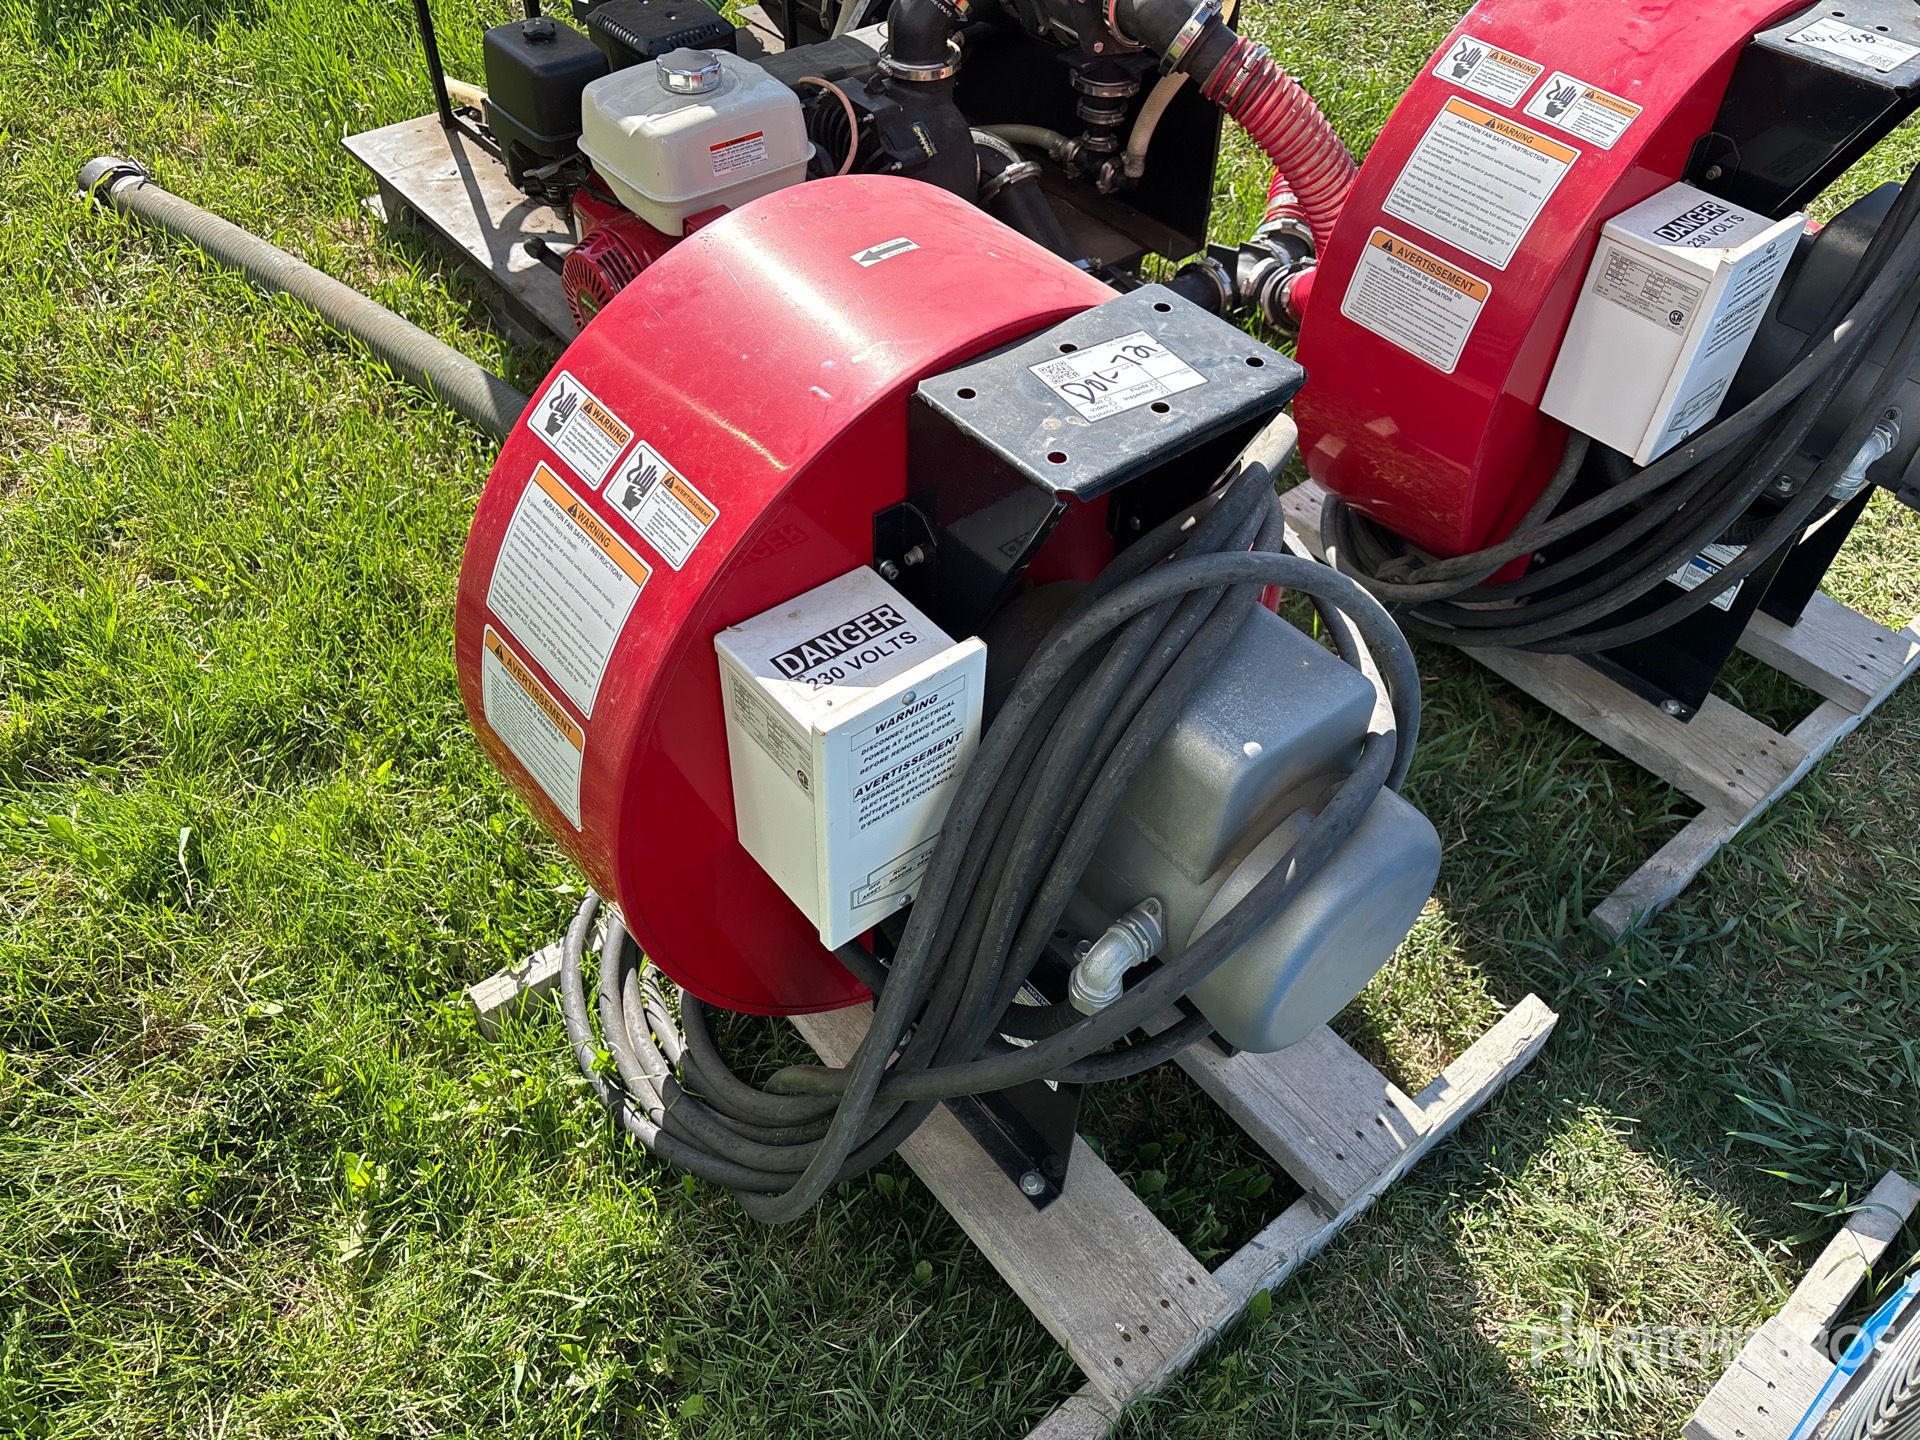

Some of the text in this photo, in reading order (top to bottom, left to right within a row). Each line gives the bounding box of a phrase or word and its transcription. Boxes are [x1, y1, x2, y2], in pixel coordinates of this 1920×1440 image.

[1499, 55, 1538, 74] WARNING
[1595, 95, 1635, 114] AVERTISSEMENT
[1455, 119, 1549, 164] AERATION FAN SAFETY INSTRUCTIONS
[1495, 122, 1534, 144] WARNING
[1656, 202, 1728, 241] DANGER
[1687, 214, 1744, 248] 230 VOLTS
[1386, 256, 1462, 299] INSTRUCTIONS DE SÉCURITÉ DU
[1389, 266, 1453, 302] VENTILATEUR D'AÉRATION
[1396, 246, 1474, 292] AVERTISSEMENT
[1123, 388, 1155, 401] Inspection
[1129, 384, 1150, 392] Fluids
[591, 408, 627, 443] WARNING
[1089, 404, 1108, 412] Video
[578, 412, 618, 451] ELECTROCUTION HAZARD
[674, 483, 710, 520] AVERTISSEMENT
[542, 496, 623, 582] AERATION FAN SAFETY INSTRUCTIONS
[576, 509, 611, 549] WARNING
[774, 603, 904, 676] DANGER
[804, 629, 918, 691] 230 VOLTS
[506, 655, 572, 738] AVERTISSEMENT
[875, 693, 937, 735] WARNING
[860, 717, 955, 775] BEFORE REMOVING COVER
[861, 699, 955, 755] DISCONNECT ELECTRICAL
[863, 710, 951, 763] POWER AT SERVICE BOX
[854, 730, 962, 798] AVERTISSEMENT
[861, 745, 956, 804] DÉBRANCHER LE COURANT
[906, 776, 916, 786] AU
[918, 760, 945, 779] NIVEAU
[946, 753, 956, 763] DU
[858, 762, 956, 822] BOÎTIER DE SERVICE AVANT
[860, 802, 899, 830] D'ENLEVER
[902, 796, 910, 806] LE
[893, 865, 906, 875] RUN
